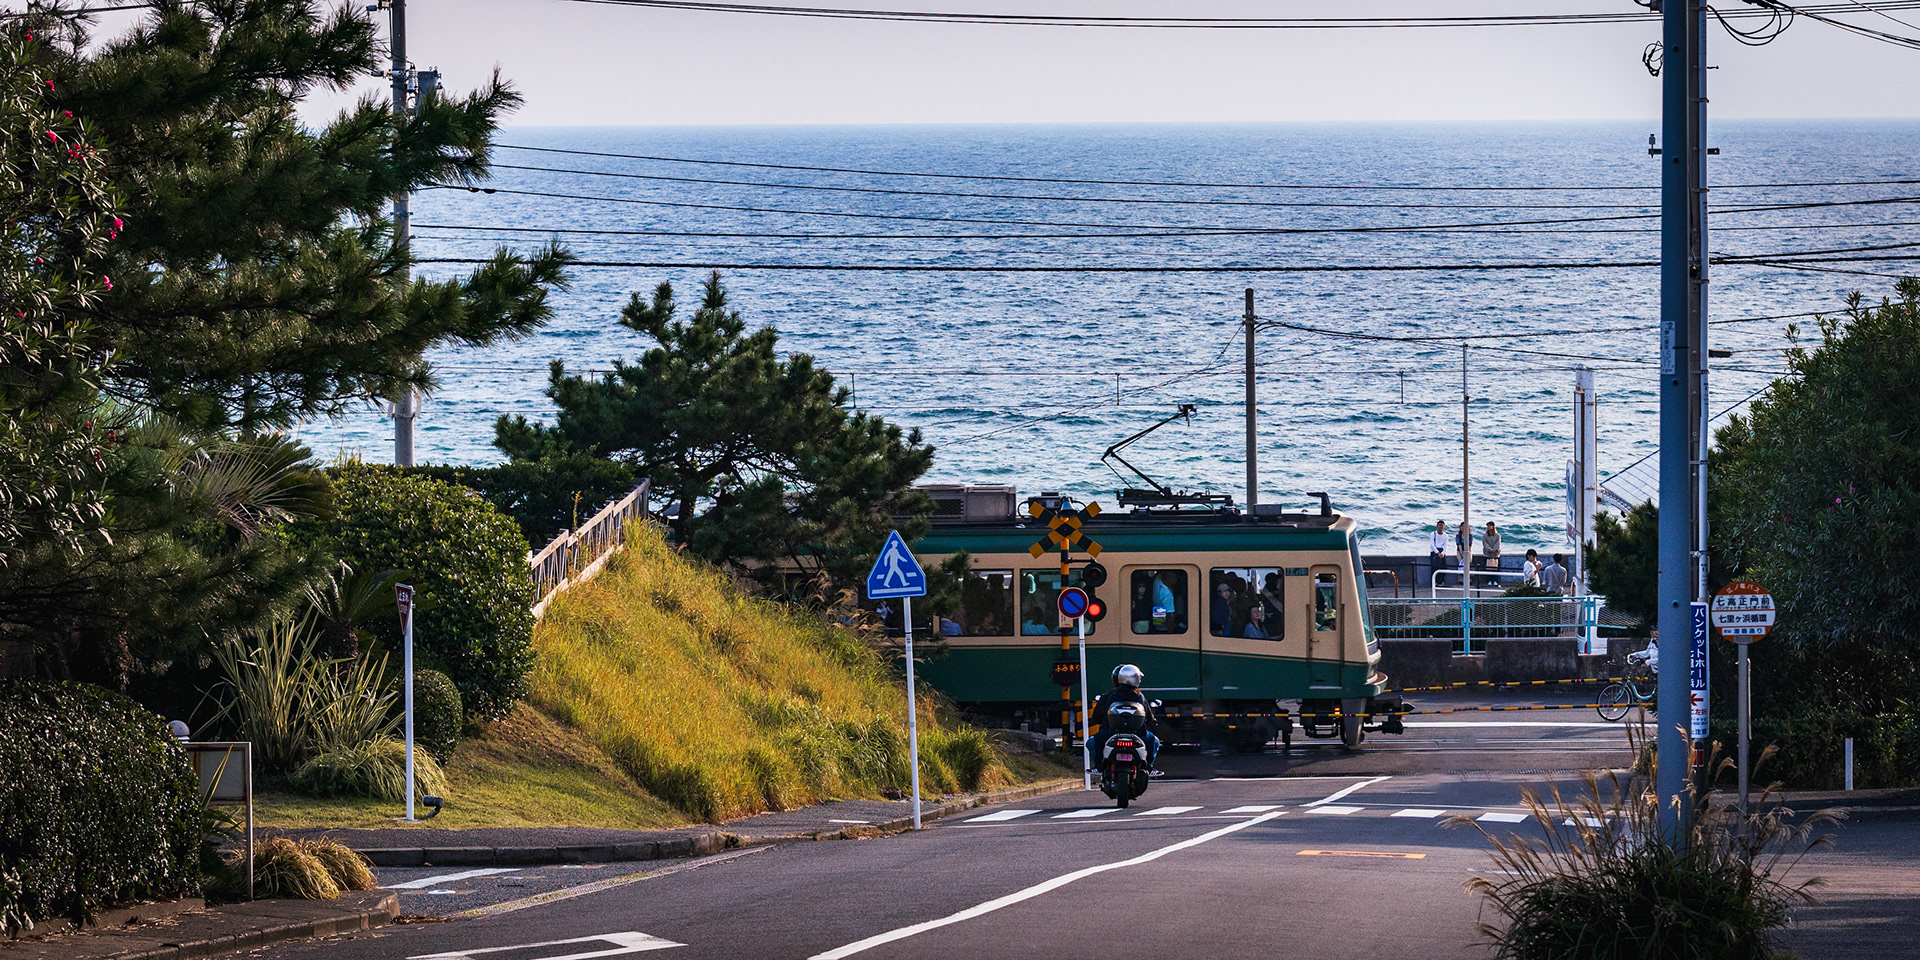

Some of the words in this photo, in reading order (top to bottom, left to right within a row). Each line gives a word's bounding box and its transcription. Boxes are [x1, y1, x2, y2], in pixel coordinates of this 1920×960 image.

[1726, 583, 1760, 594] 江ノ電バス
[1716, 597, 1770, 606] 七高正門前
[1718, 614, 1767, 623] 七里ヶ浜循環
[1694, 607, 1706, 688] バンケットホール
[1054, 664, 1081, 672] ふみきり
